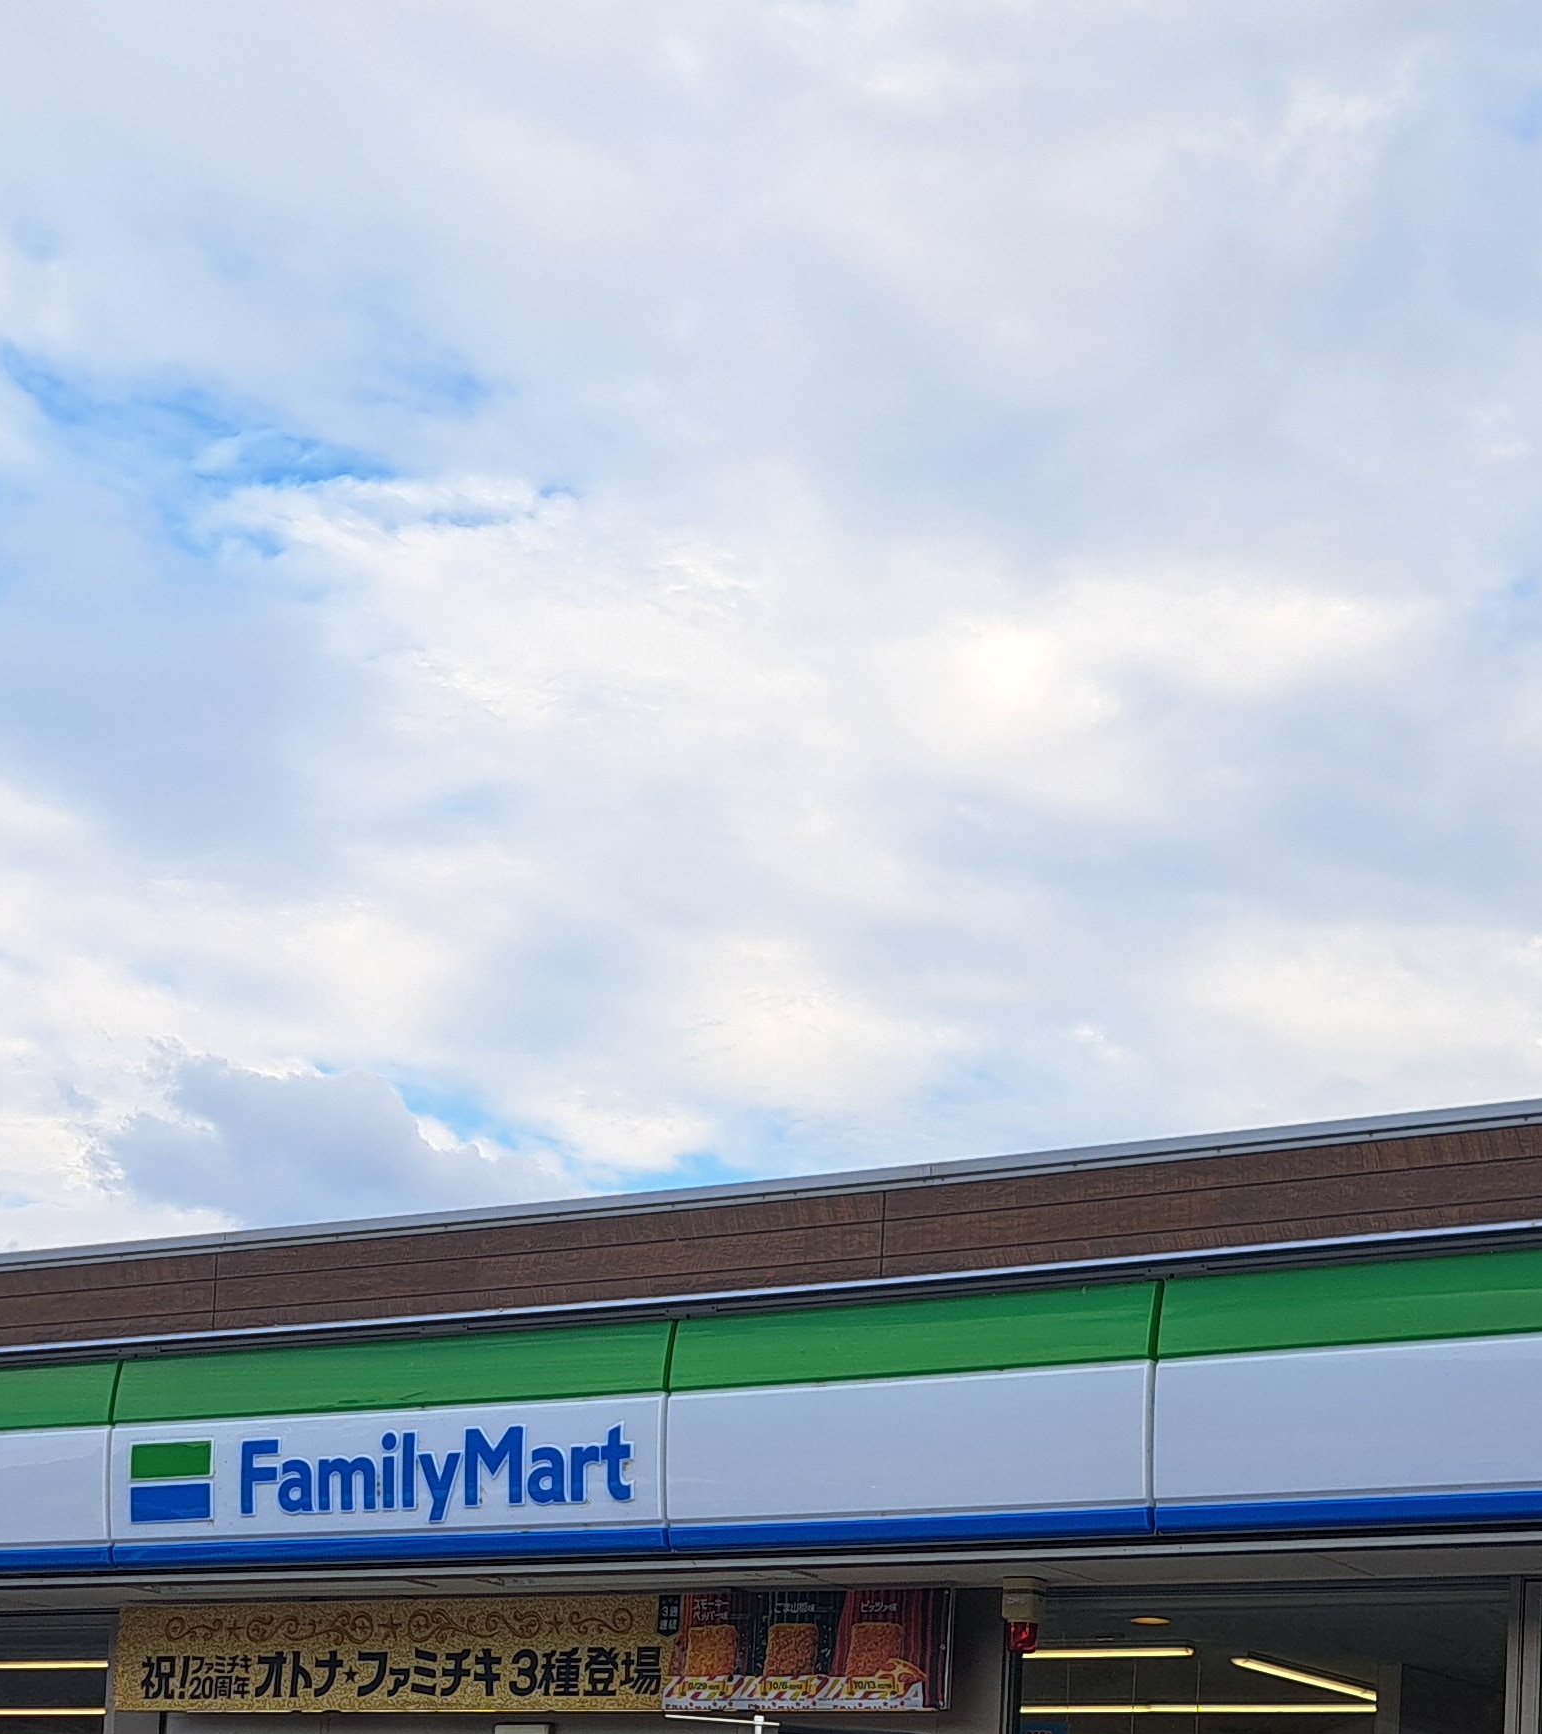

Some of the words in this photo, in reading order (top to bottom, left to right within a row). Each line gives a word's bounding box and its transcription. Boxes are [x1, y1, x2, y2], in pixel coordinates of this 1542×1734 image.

[241, 1423, 633, 1522] FamilyMart
[190, 1655, 252, 1675] ファミチキ
[509, 1647, 662, 1697] 3種登場
[189, 1675, 251, 1699] 20周年
